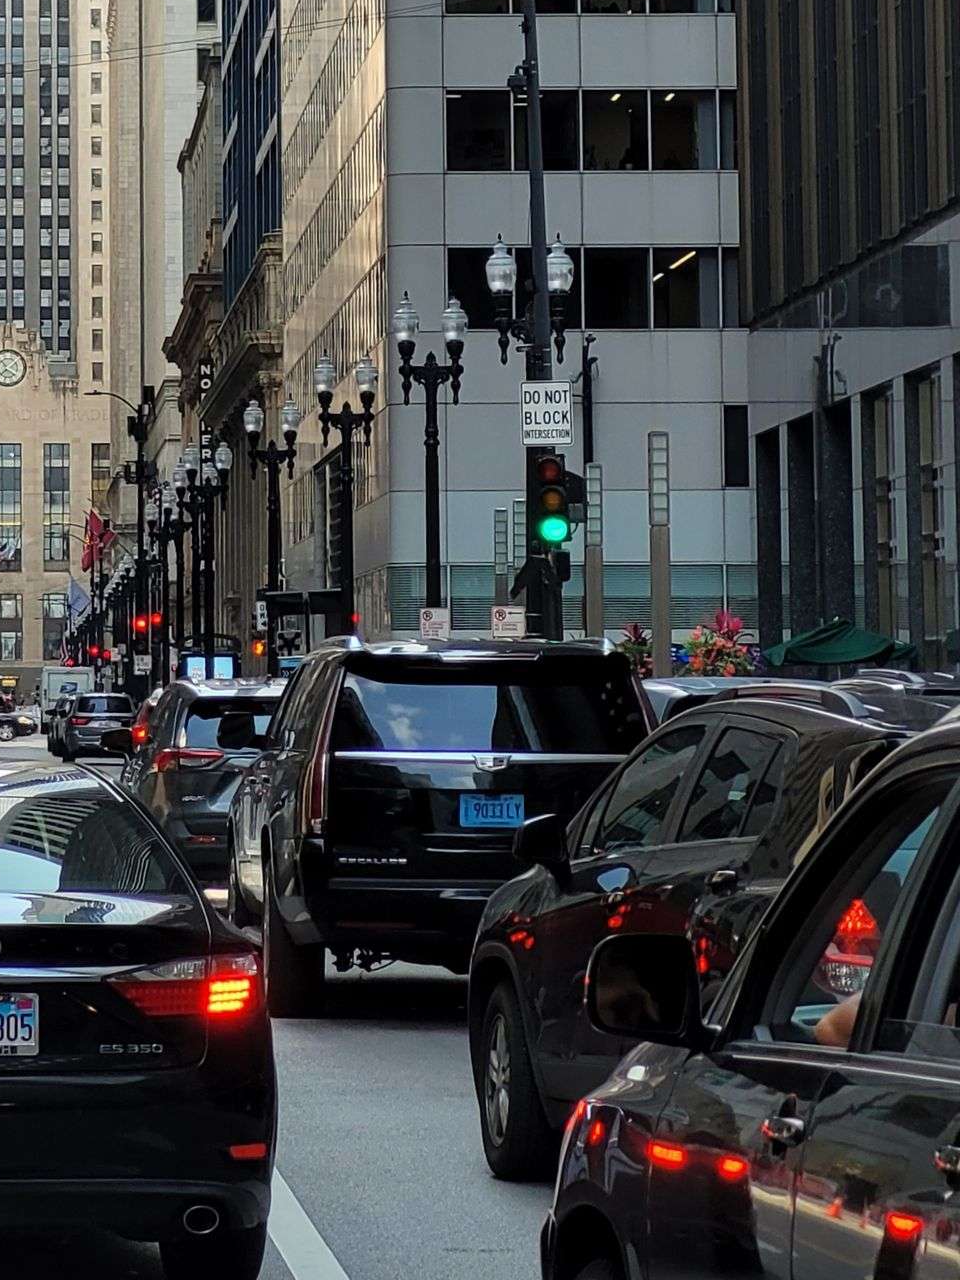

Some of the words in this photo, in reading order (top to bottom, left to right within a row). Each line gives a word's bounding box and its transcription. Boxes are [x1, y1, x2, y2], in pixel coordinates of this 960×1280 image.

[524, 391, 540, 404] DO
[545, 390, 568, 404] NOT
[525, 411, 569, 425] BLOCK
[524, 429, 570, 439] INTERSECTION
[99, 1044, 124, 1053] ES
[127, 1043, 163, 1053] 350
